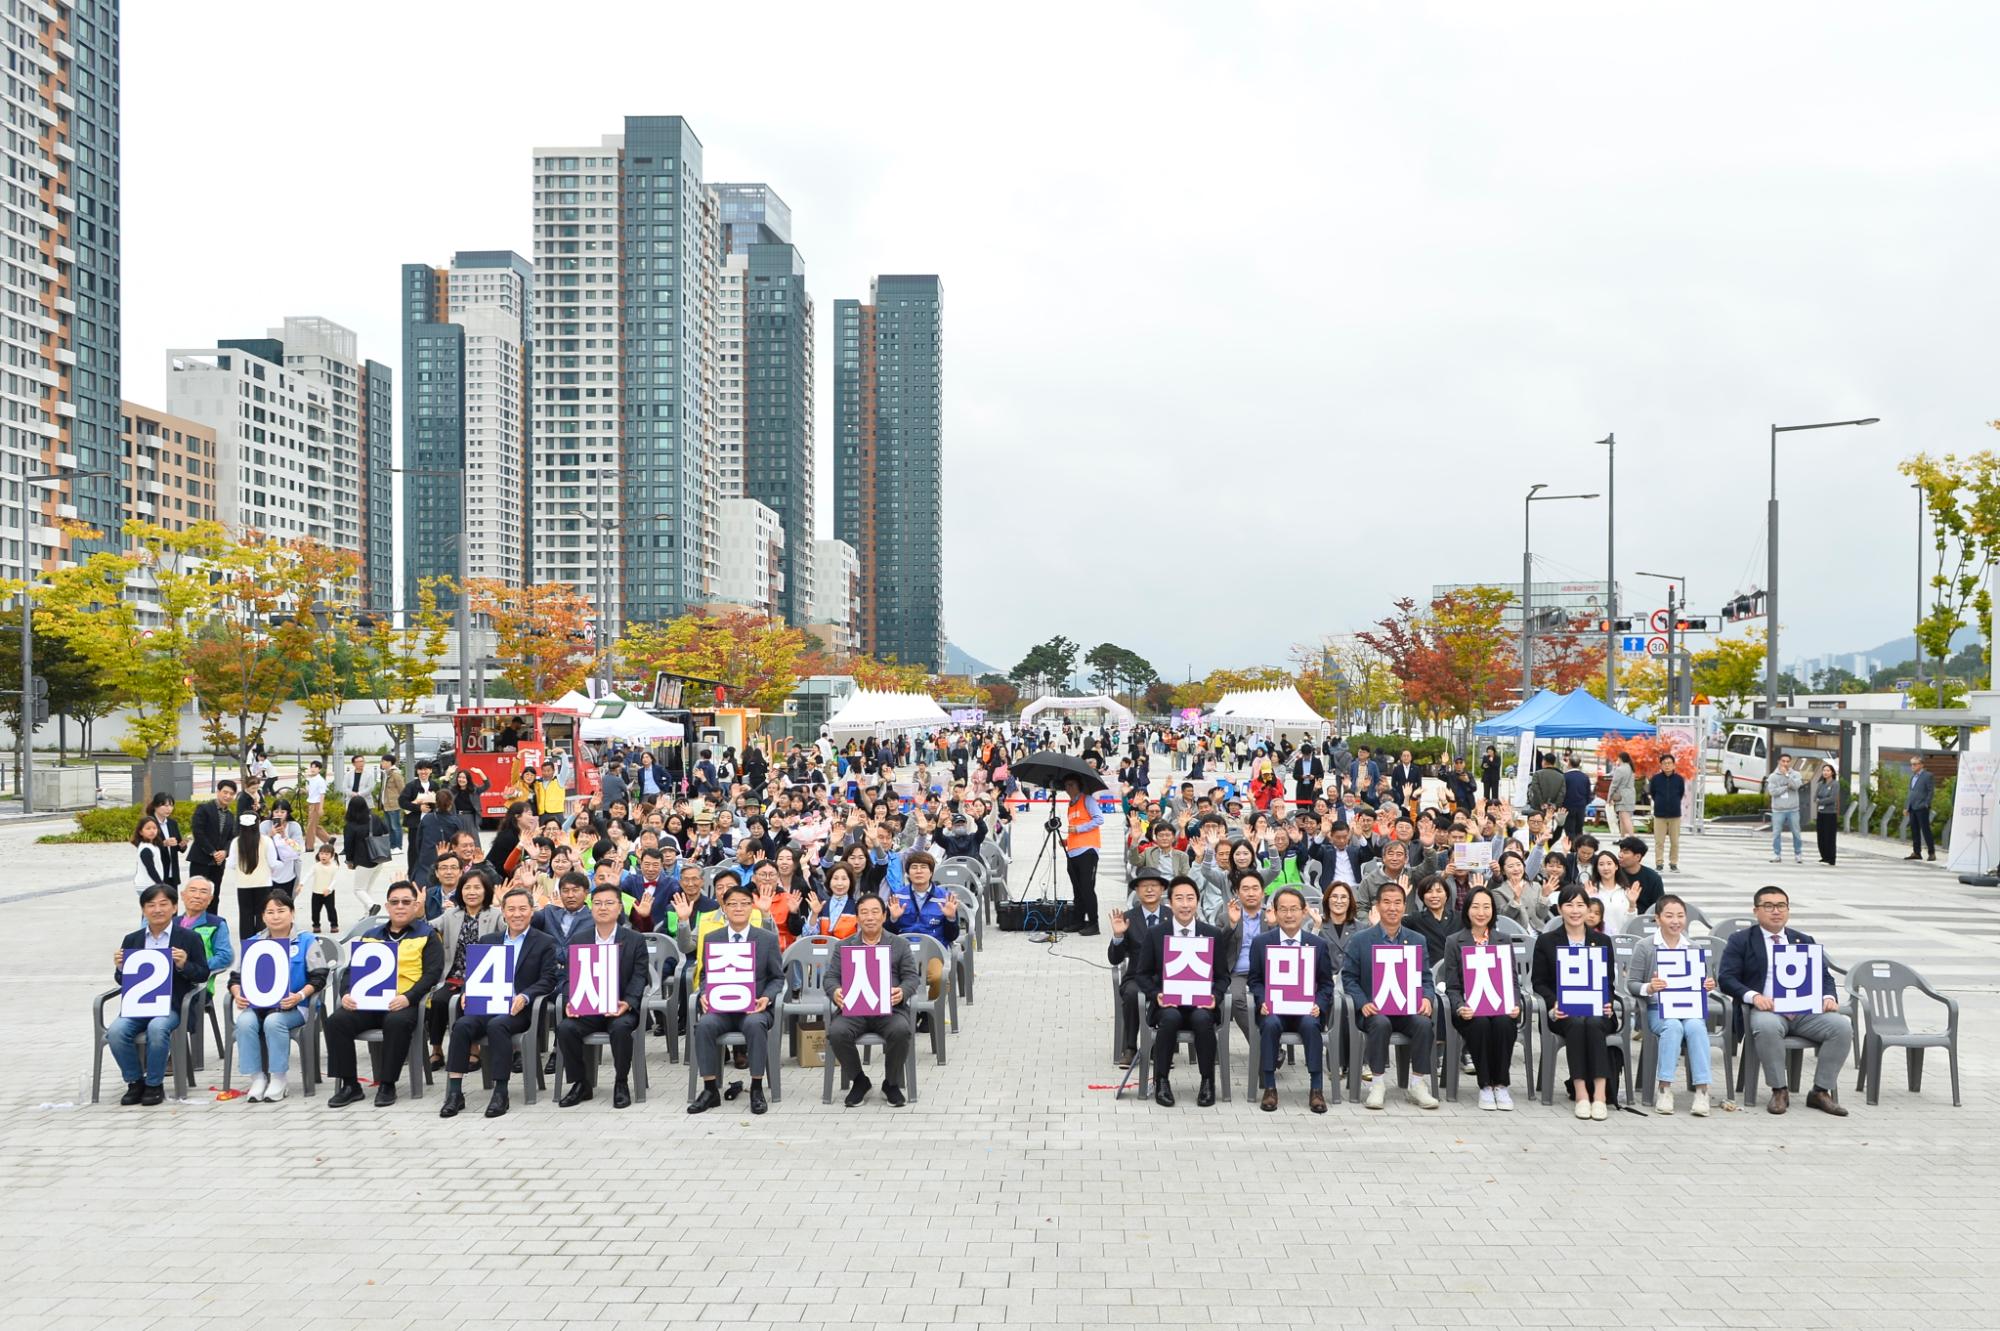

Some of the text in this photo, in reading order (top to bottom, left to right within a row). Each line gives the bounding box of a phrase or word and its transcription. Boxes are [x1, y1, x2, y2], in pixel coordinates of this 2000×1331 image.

[1651, 643, 1664, 652] 30
[122, 940, 513, 1017] 2 0 2 4
[571, 943, 891, 1014] 세 종 시
[1163, 937, 1515, 1015] 주 민 자 치
[1558, 945, 1822, 1018] 박 람 회
